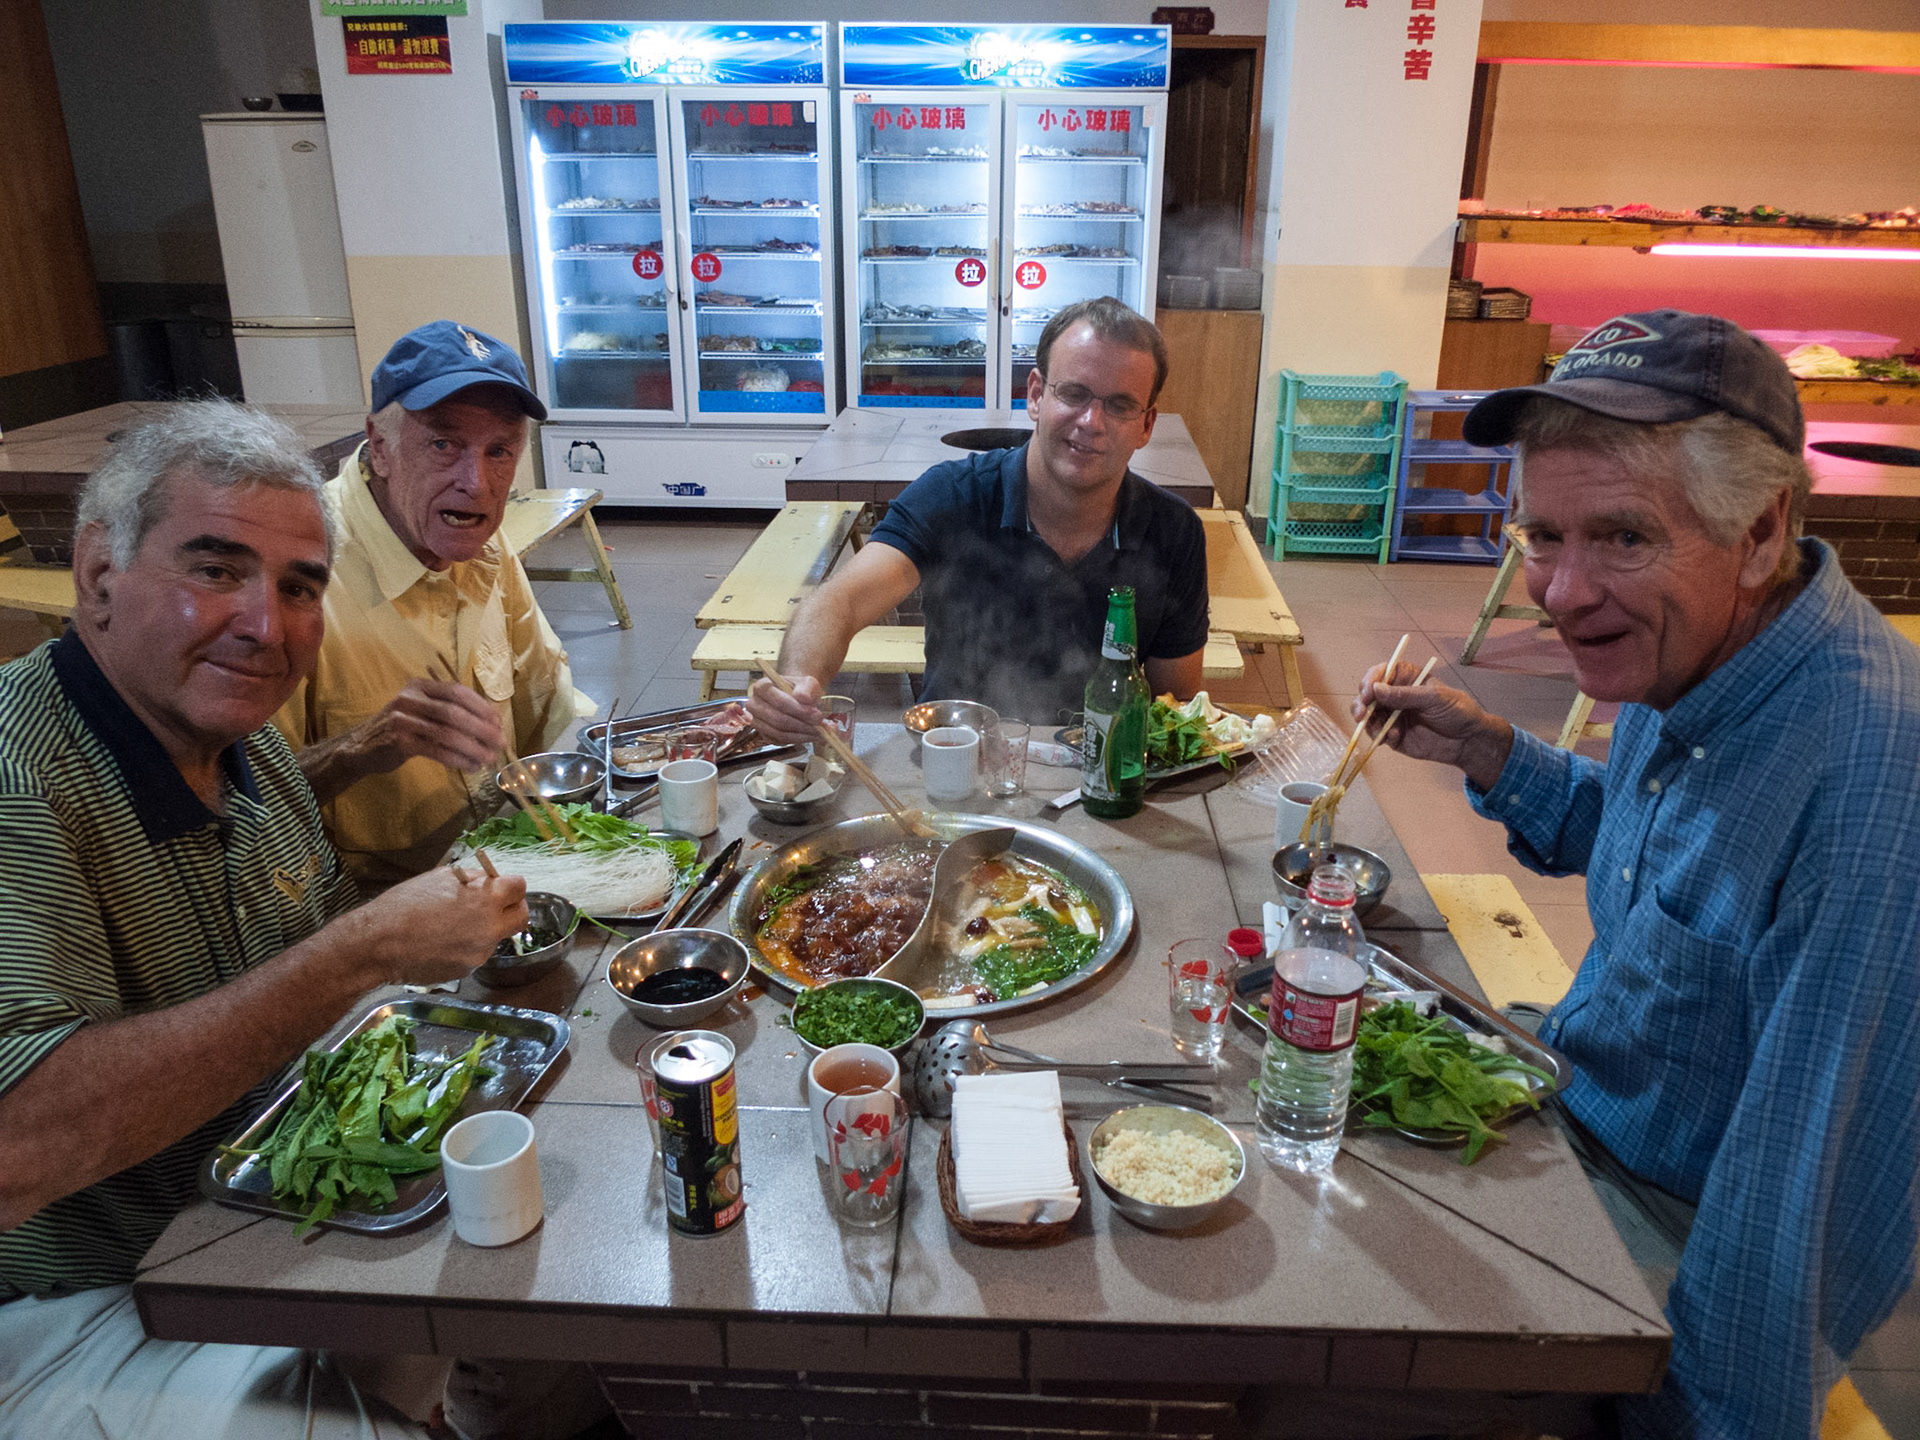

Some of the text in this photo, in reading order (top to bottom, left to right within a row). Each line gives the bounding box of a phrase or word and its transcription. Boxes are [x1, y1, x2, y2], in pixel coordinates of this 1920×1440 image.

[546, 104, 637, 128] 小心玻璃
[701, 103, 793, 127] 小心玻璃
[872, 106, 965, 130] 小心玻璃
[1037, 108, 1131, 133] 小心玻璃
[639, 256, 657, 274] 拉
[698, 258, 716, 277] 拉
[961, 263, 981, 282] 拉
[1021, 265, 1040, 286] 拉
[1594, 328, 1621, 344] CO
